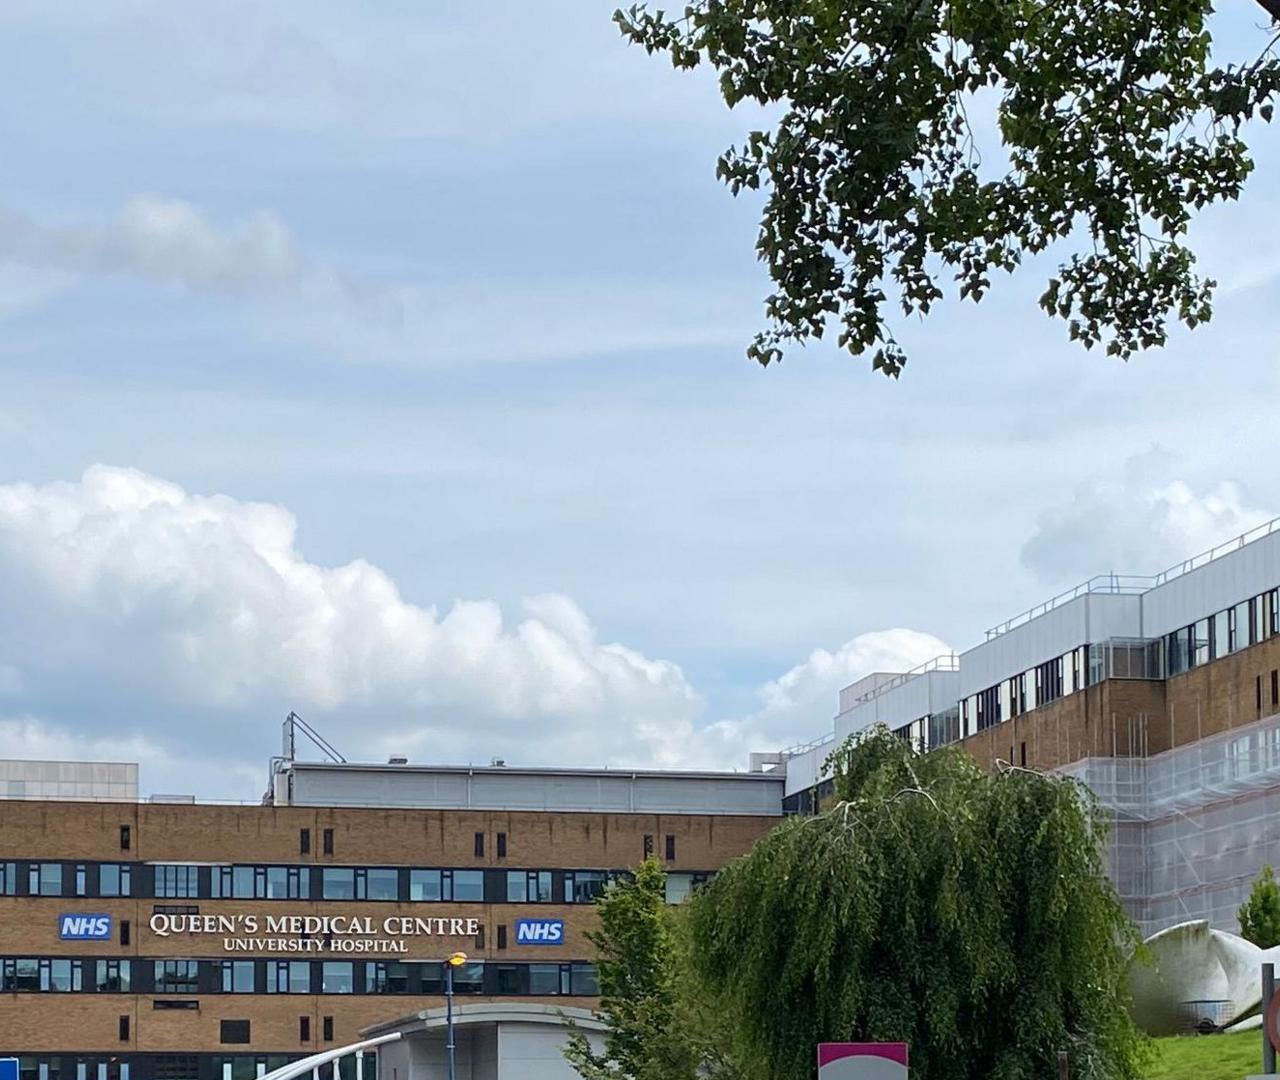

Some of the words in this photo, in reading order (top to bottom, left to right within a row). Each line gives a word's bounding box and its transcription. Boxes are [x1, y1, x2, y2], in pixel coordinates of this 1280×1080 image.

[61, 917, 110, 936] NHS
[150, 914, 258, 937] QUEEN'S
[265, 916, 378, 936] MEDICAL
[383, 917, 480, 937] CENTRE
[518, 922, 563, 941] NHS
[223, 938, 325, 952] UNIVERSITY
[330, 939, 409, 953] HOSPITAL
